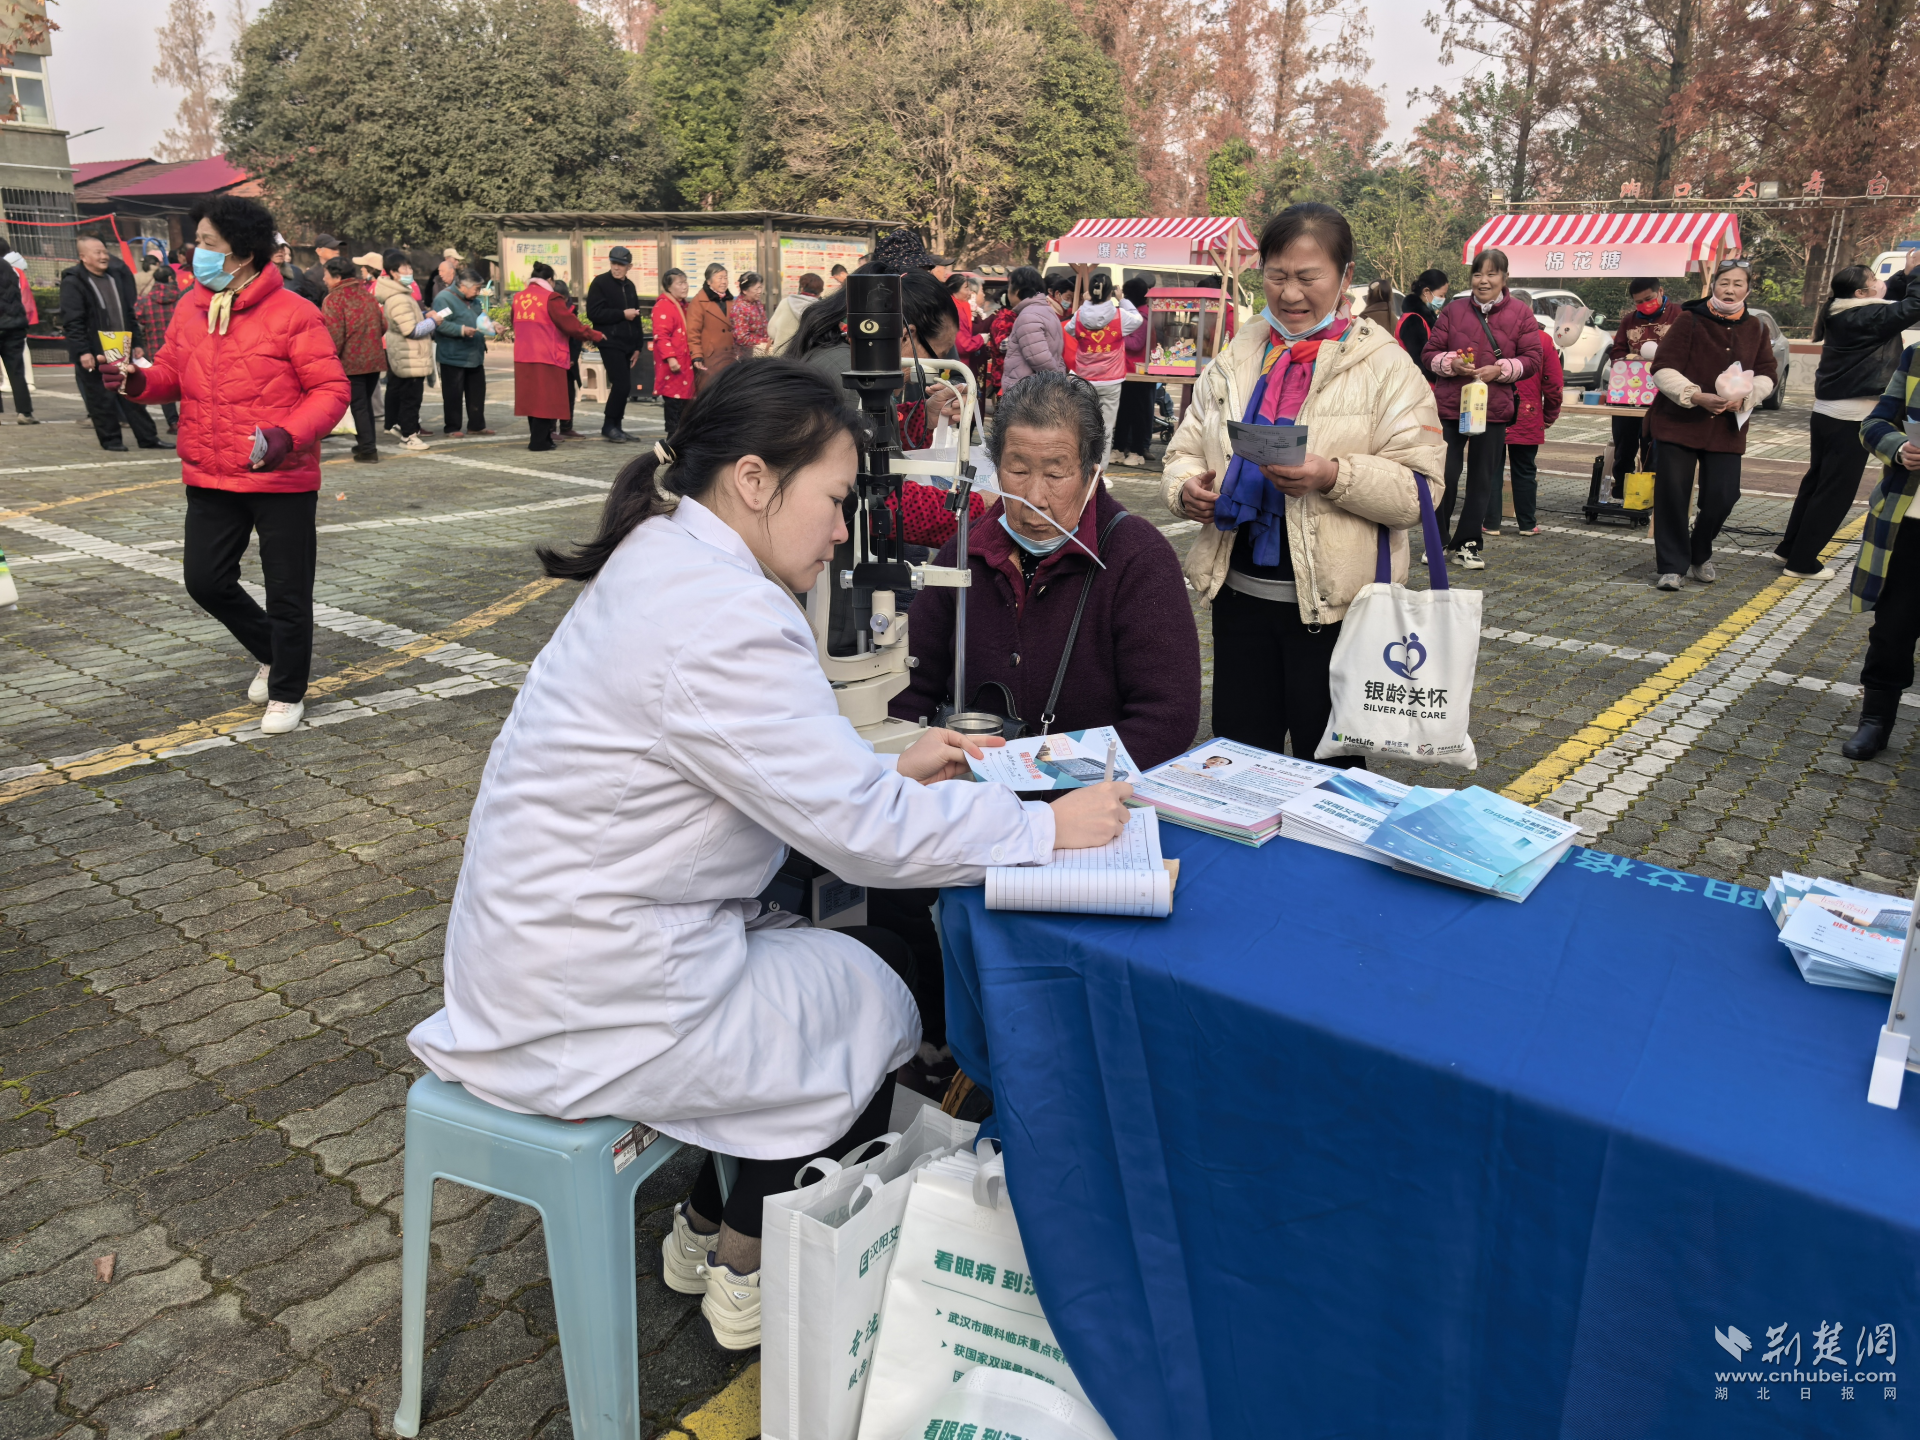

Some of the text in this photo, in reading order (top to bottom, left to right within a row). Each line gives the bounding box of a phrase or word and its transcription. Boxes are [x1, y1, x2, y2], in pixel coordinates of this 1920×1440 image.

[1097, 242, 1147, 259] 爆米花
[1545, 250, 1621, 271] 棉花糖
[1364, 680, 1448, 708] 银龄关怀
[1363, 703, 1447, 719] SILVER AGE CARE
[1344, 735, 1374, 746] MetLife
[1559, 846, 1764, 910] 阳艾格
[870, 1225, 901, 1260] 汉阳艾
[934, 1249, 996, 1285] 看眼病
